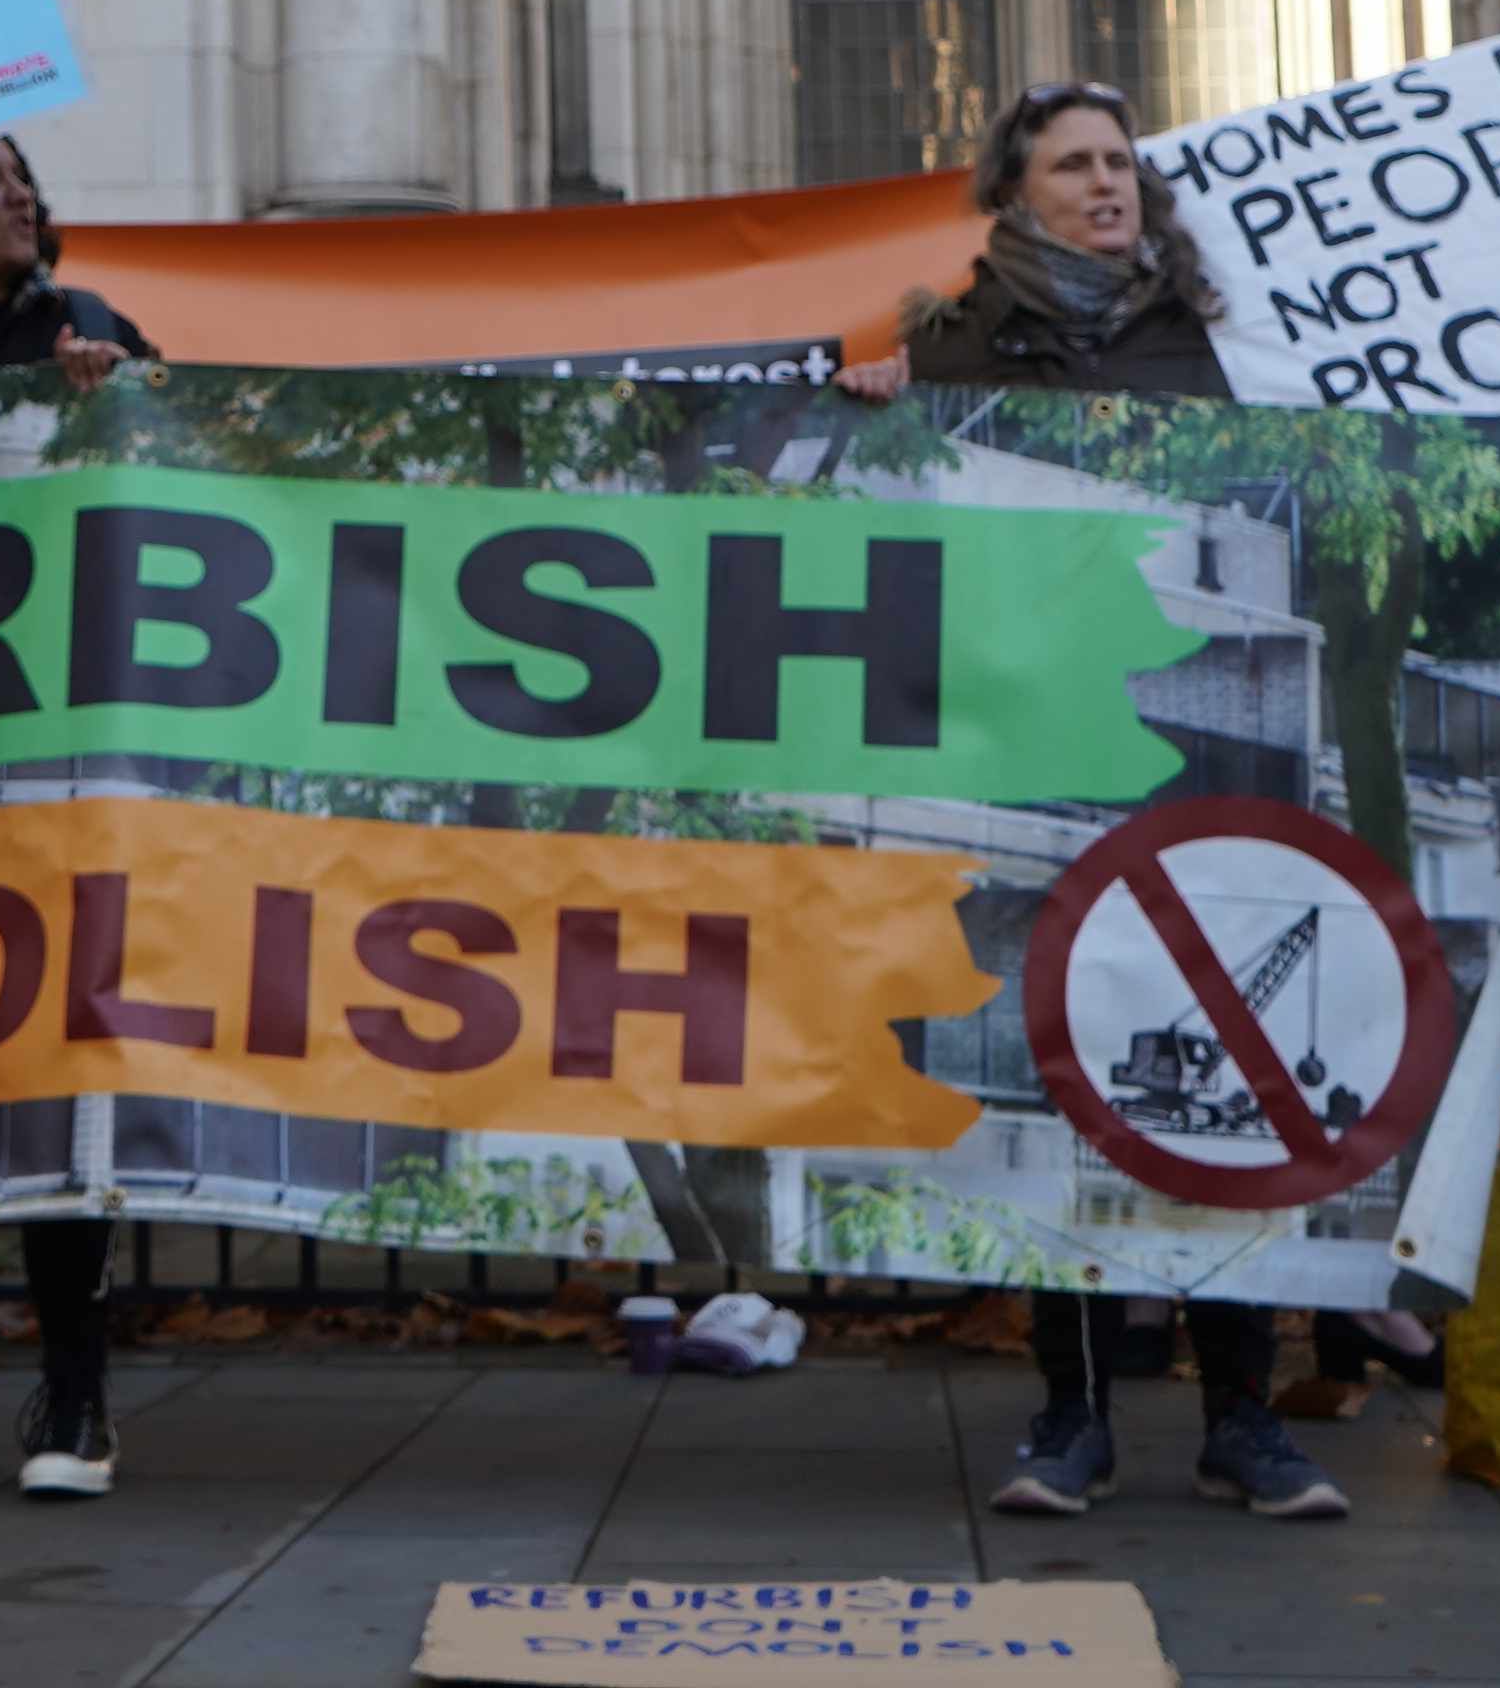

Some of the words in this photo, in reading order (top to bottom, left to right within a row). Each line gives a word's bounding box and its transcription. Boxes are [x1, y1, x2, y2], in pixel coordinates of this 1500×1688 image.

[1146, 68, 1451, 195] HOMES
[1270, 241, 1443, 343] NOT
[468, 1586, 973, 1612] REFURBISH
[616, 1616, 944, 1635] DON'T
[523, 1636, 1073, 1658] DEMOLISH
